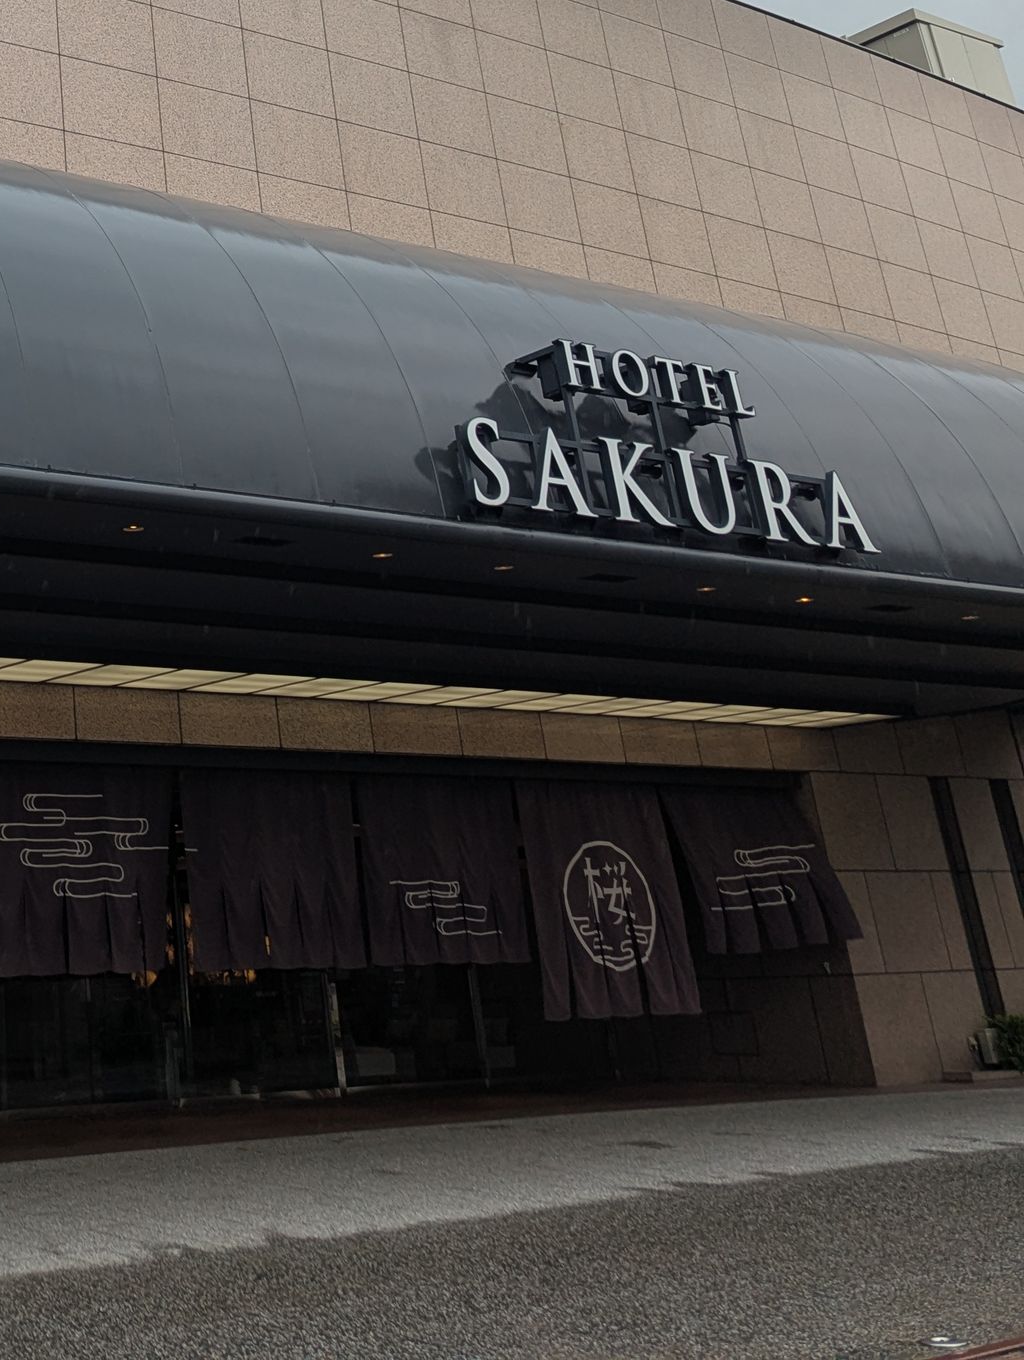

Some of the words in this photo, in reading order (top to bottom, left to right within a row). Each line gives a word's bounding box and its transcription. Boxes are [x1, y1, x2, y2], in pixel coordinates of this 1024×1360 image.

[557, 339, 755, 417] HOTEL
[466, 416, 881, 553] SAKURA
[583, 857, 636, 925] 桜
